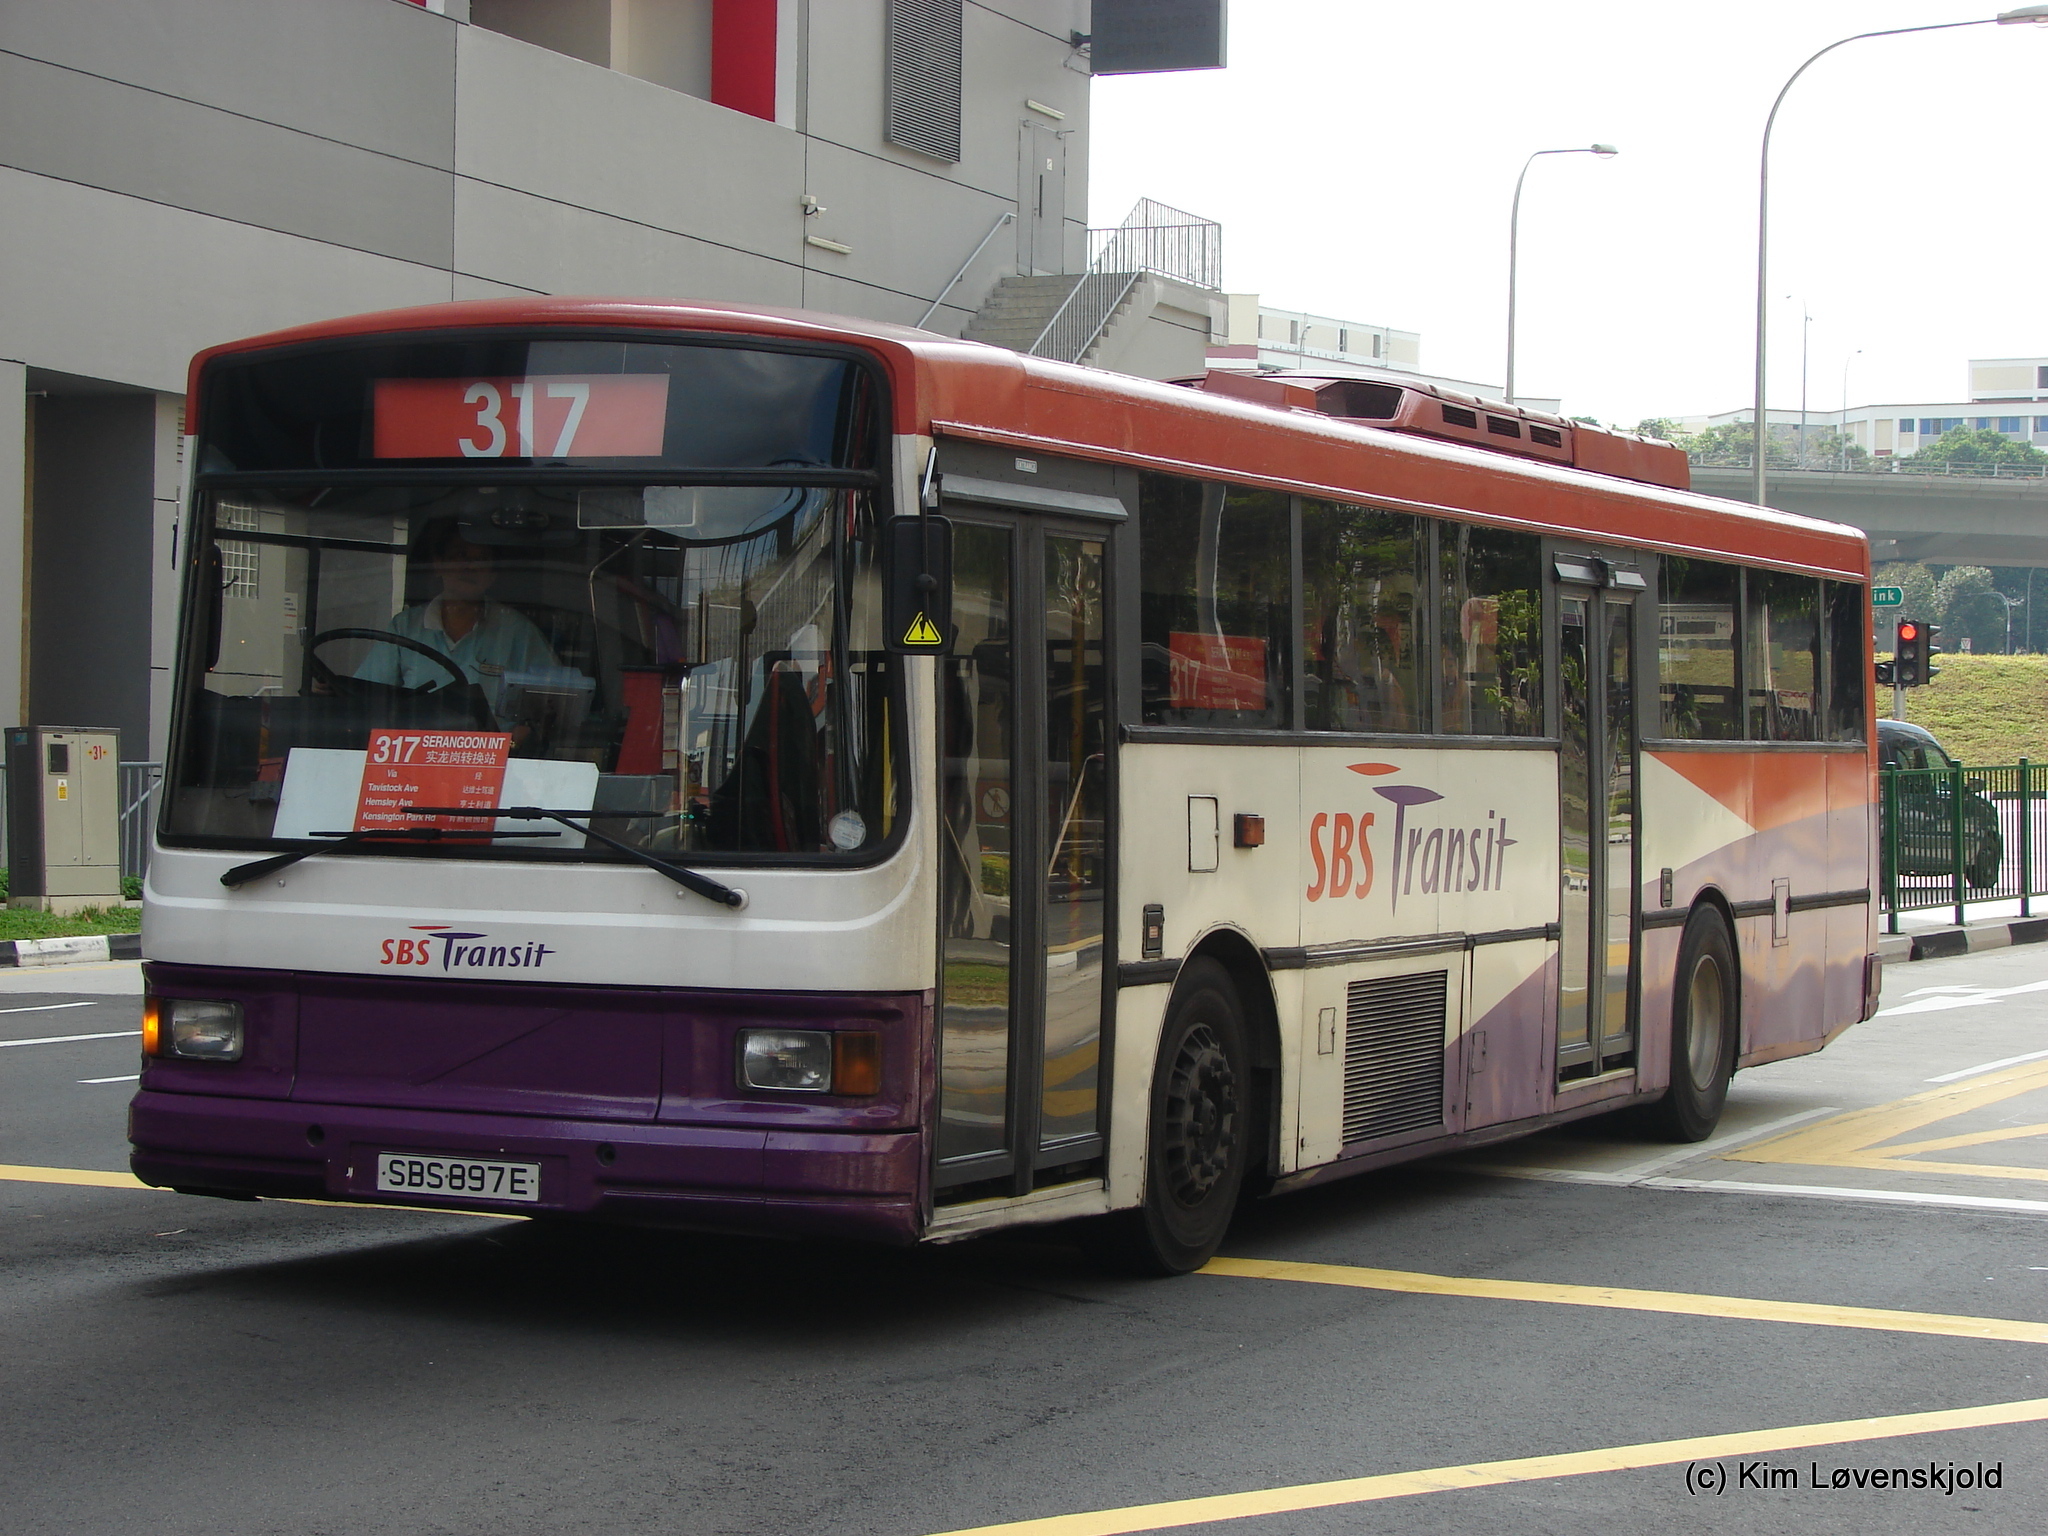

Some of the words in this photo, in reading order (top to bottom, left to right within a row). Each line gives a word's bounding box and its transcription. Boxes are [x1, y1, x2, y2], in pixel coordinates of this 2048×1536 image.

[459, 382, 590, 457] 317
[1873, 590, 1895, 601] ink
[1169, 658, 1201, 700] 317
[93, 745, 102, 760] 31
[373, 735, 421, 763] 317
[422, 735, 488, 749] SERANGOON
[488, 737, 506, 749] INT
[426, 750, 497, 765] 实龙岗转换站
[387, 769, 398, 778] Via
[368, 783, 403, 792] Tavistock
[403, 783, 419, 792] Ave
[365, 797, 397, 808] Hemsley
[398, 799, 414, 807] Ave
[362, 812, 405, 823] Kensington
[406, 813, 424, 821] Park
[1307, 812, 1375, 902] SBS
[1372, 785, 1518, 917] Transit
[380, 939, 430, 966] SBS
[427, 932, 557, 972] Transit
